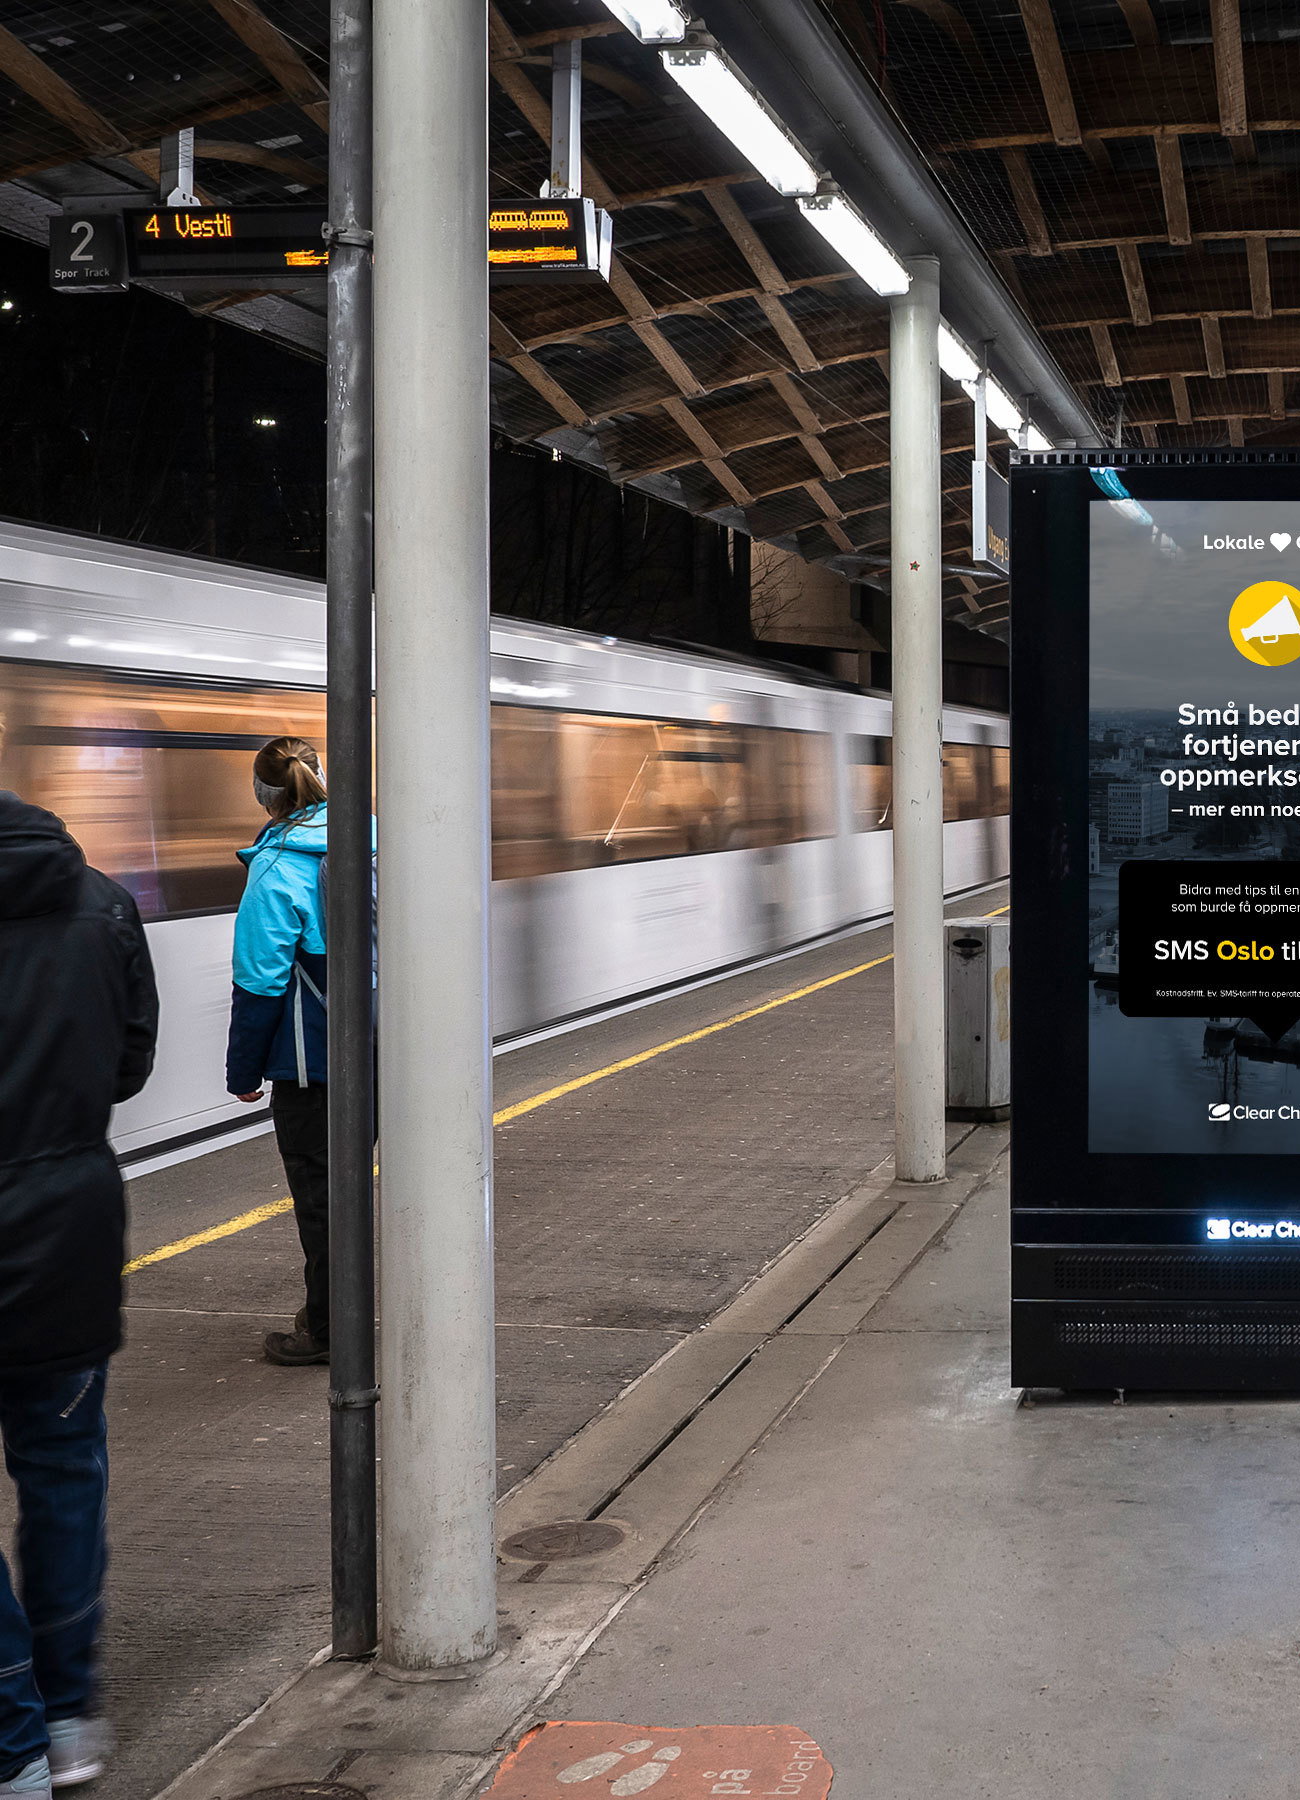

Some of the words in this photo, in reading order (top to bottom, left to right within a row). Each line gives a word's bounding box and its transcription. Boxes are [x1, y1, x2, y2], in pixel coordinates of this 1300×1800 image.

[145, 213, 161, 239] 4
[174, 212, 233, 239] Vestli
[70, 221, 94, 262] 2
[54, 268, 79, 280] Spor
[84, 267, 110, 278] Track
[1203, 534, 1265, 551] Lokale
[1178, 700, 1239, 726] Små
[1188, 805, 1225, 818] mer
[1230, 805, 1265, 818] enn
[1179, 883, 1211, 896] Bidra
[1215, 884, 1241, 896] med
[1244, 884, 1267, 898] tips
[1269, 884, 1281, 896] til
[1284, 887, 1300, 896] en
[1171, 903, 1197, 913] som
[1200, 901, 1236, 913] burde
[1238, 900, 1251, 913] få
[1154, 939, 1209, 962] SMS
[1216, 940, 1275, 962] Oslo
[1258, 990, 1270, 998] fra
[1233, 1105, 1276, 1121] Clear
[1231, 1220, 1274, 1239] Clear
[763, 1740, 820, 1795] board
